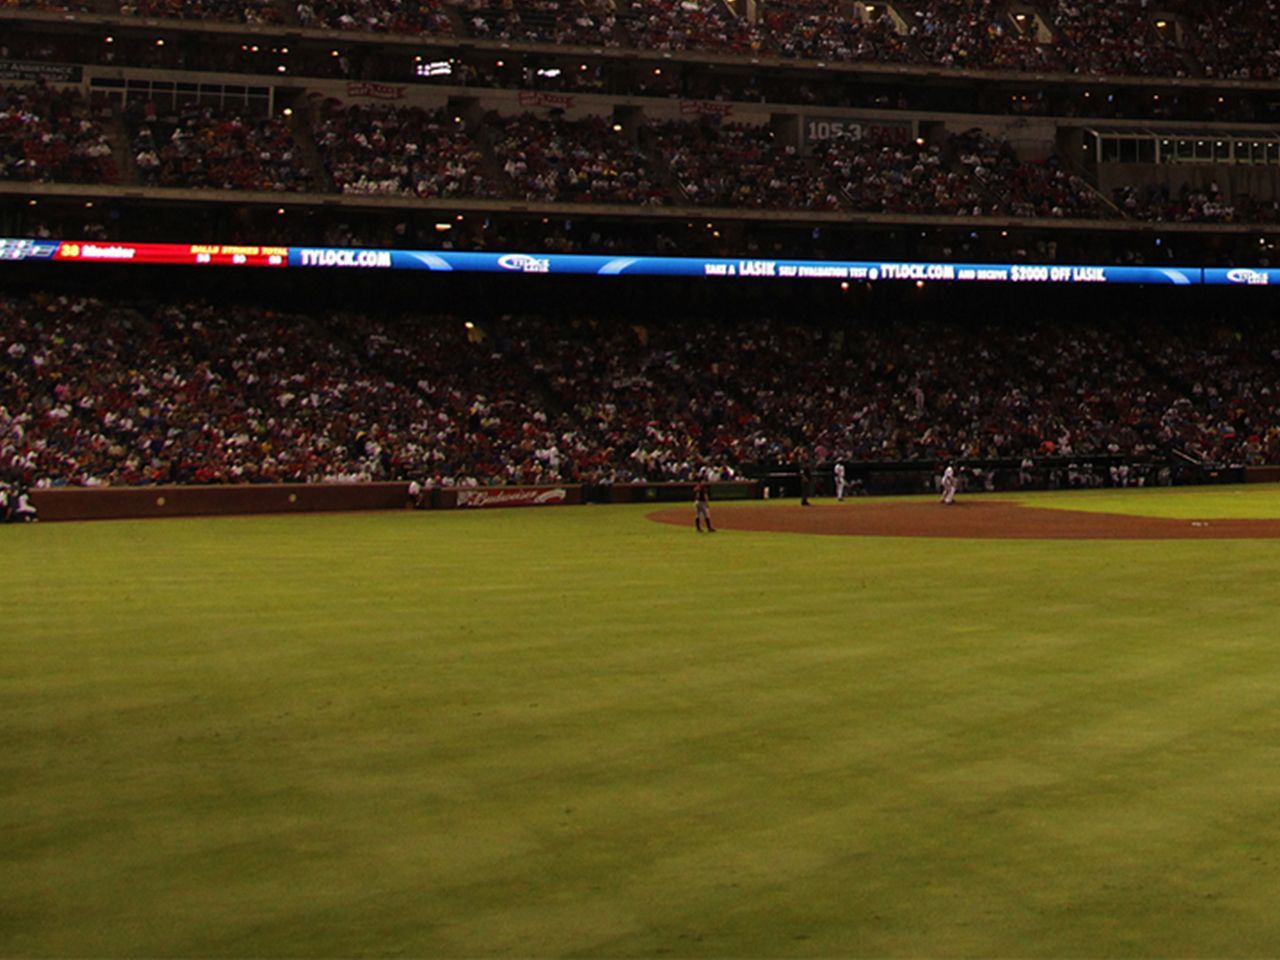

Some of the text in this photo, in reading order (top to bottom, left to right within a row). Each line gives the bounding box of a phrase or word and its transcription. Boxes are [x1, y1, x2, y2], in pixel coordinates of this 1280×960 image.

[301, 249, 391, 267] TYLOCK.COM
[739, 261, 776, 277] LASIK
[880, 264, 955, 280] TYLOCK.COM
[1011, 265, 1048, 281] $2000
[1050, 266, 1071, 281] OFF
